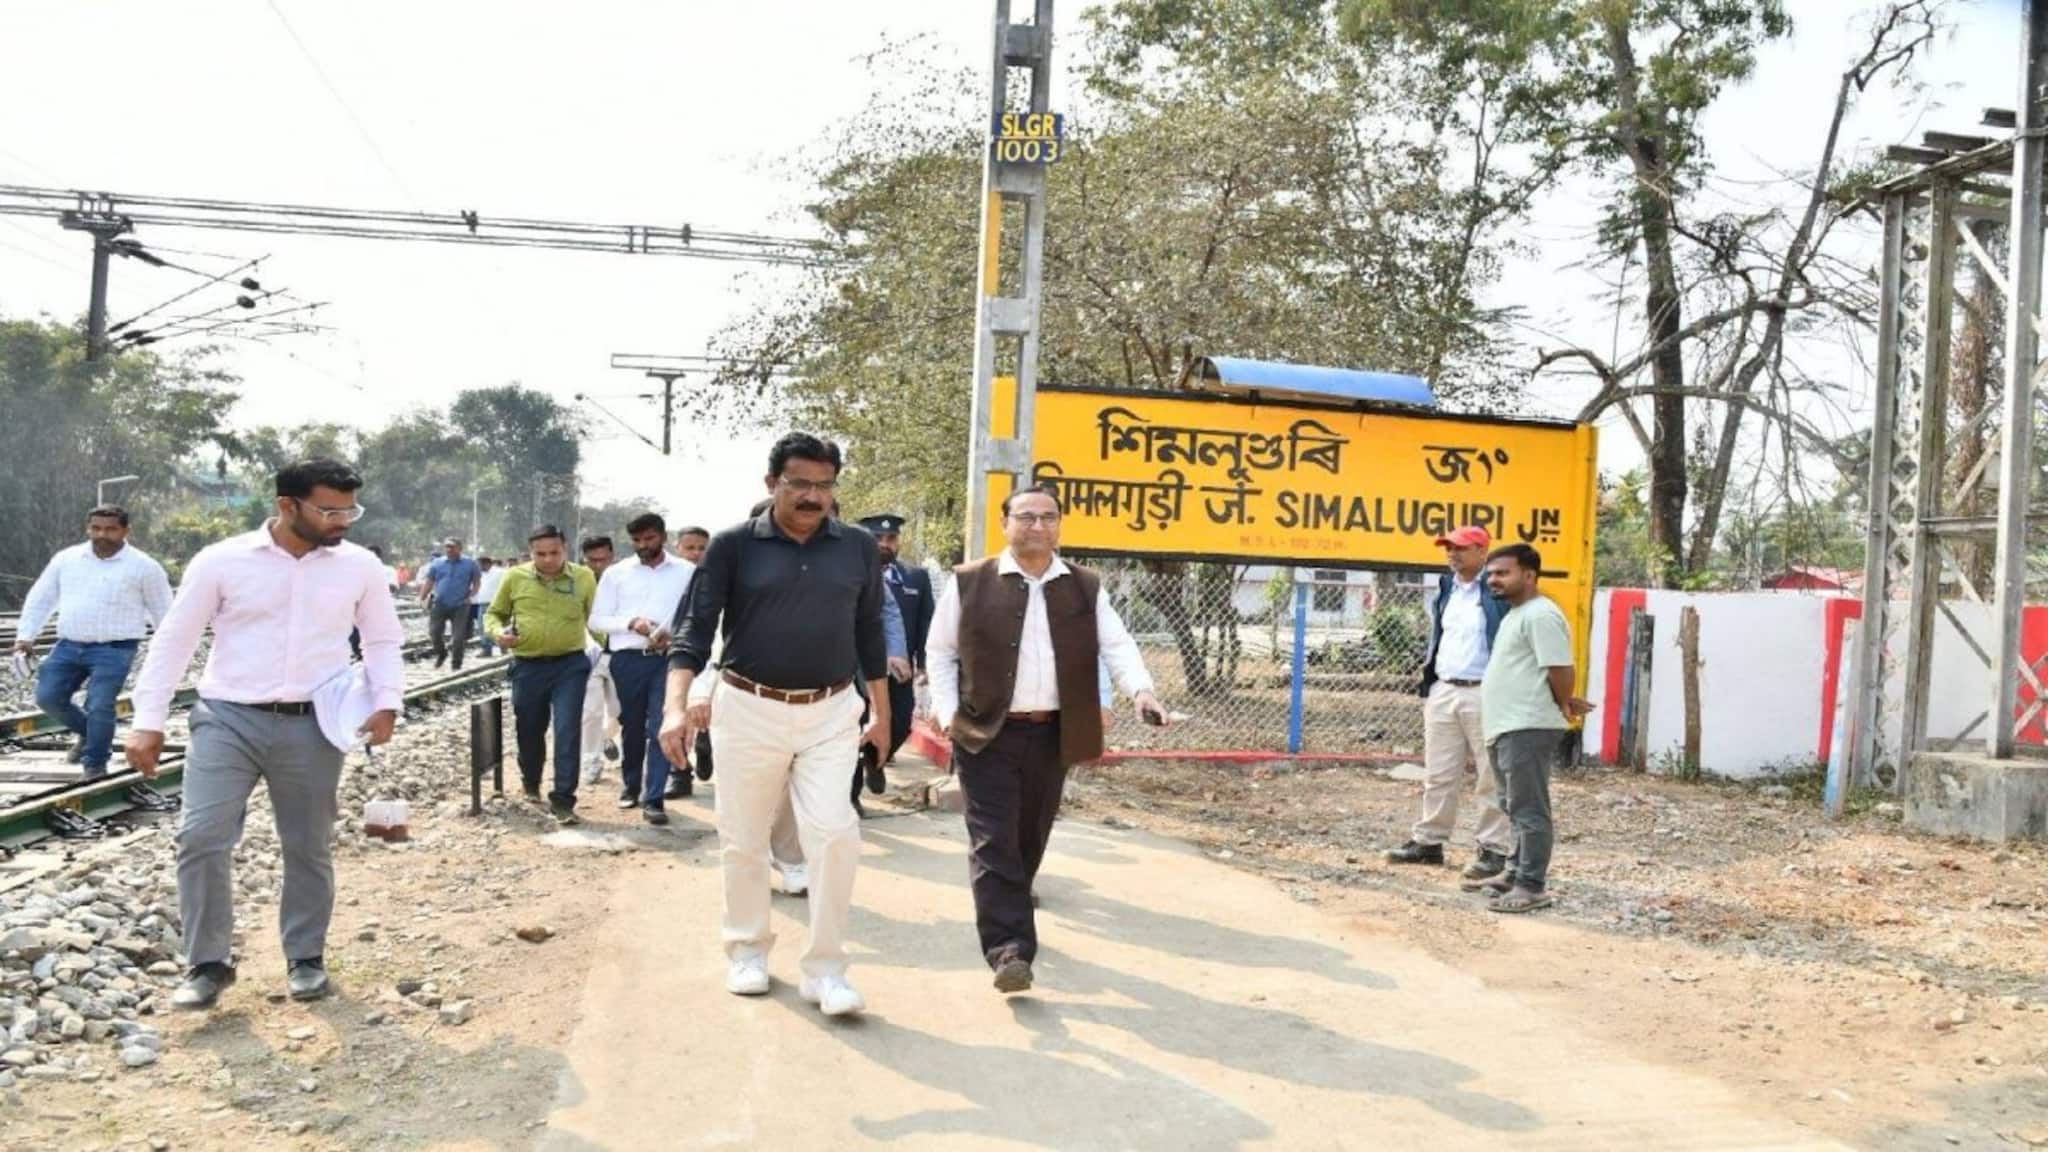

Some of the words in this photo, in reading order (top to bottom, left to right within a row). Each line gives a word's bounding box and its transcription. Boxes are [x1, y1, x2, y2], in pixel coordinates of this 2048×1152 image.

[1001, 113, 1056, 137] SLGR
[996, 140, 1058, 162] 1003
[1275, 490, 1505, 541] SIMALUGURI
